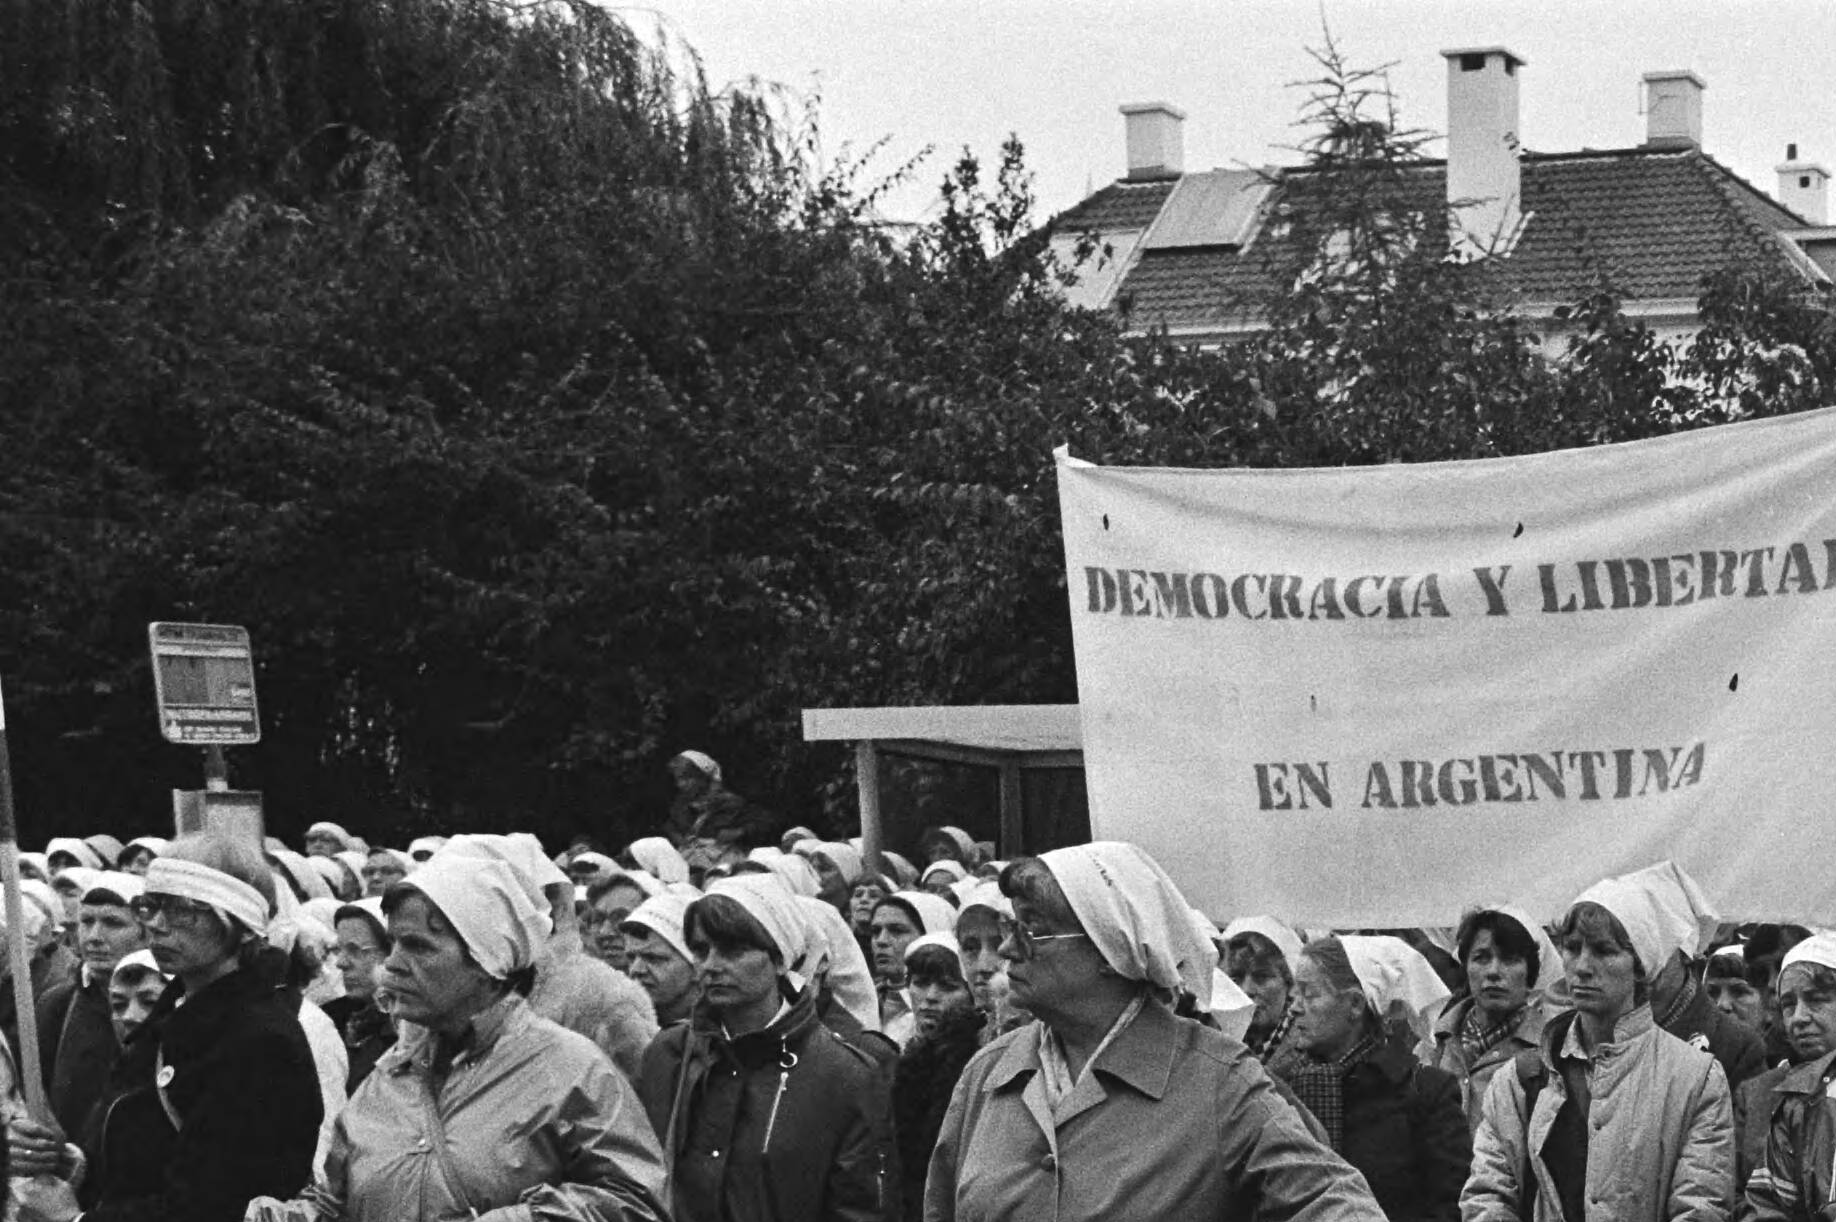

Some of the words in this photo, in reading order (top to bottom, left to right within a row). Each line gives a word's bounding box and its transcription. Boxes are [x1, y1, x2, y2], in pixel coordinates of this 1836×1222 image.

[1086, 564, 1450, 621] DEMOCRACIA
[1473, 564, 1513, 617] Y
[1254, 760, 1332, 811] EN
[1362, 740, 1706, 809] ARGENTINA
